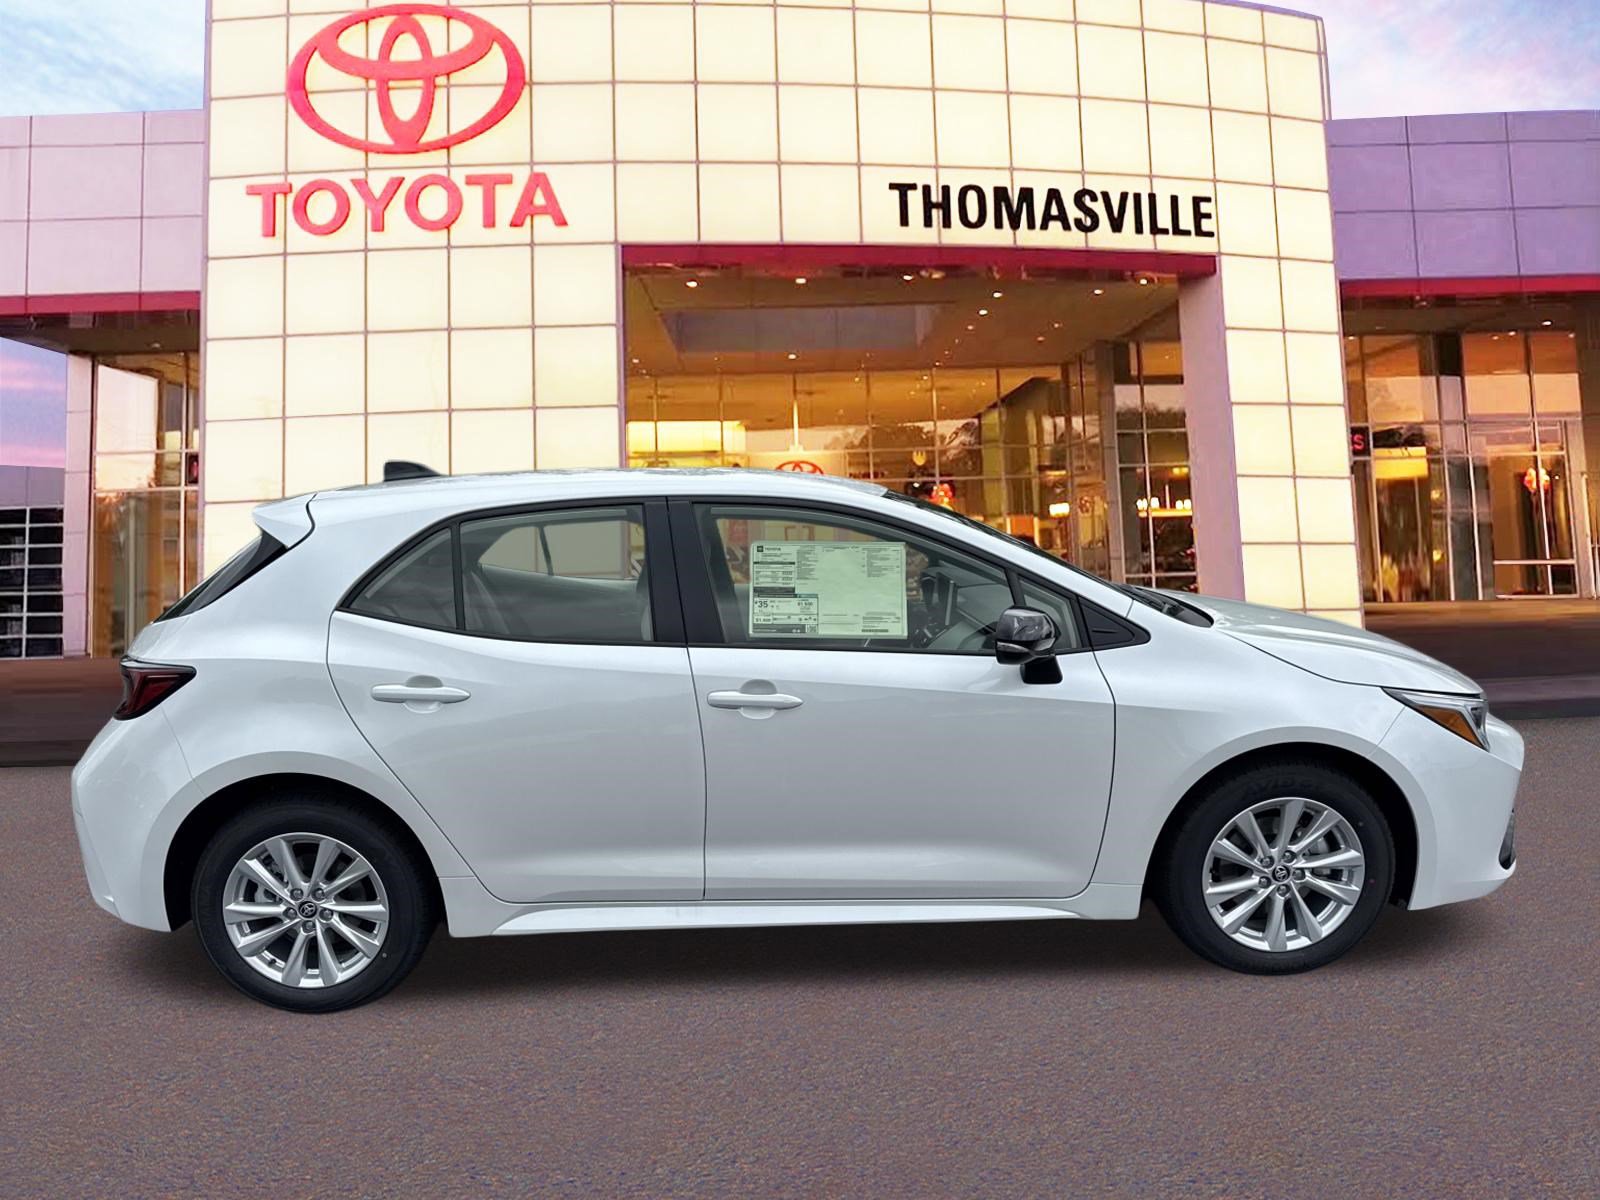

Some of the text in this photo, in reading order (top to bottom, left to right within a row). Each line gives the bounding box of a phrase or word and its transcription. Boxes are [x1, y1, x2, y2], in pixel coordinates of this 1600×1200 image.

[246, 172, 569, 237] TOYOTA
[888, 182, 1216, 238] THOMASVILLE
[757, 600, 769, 608] 35
